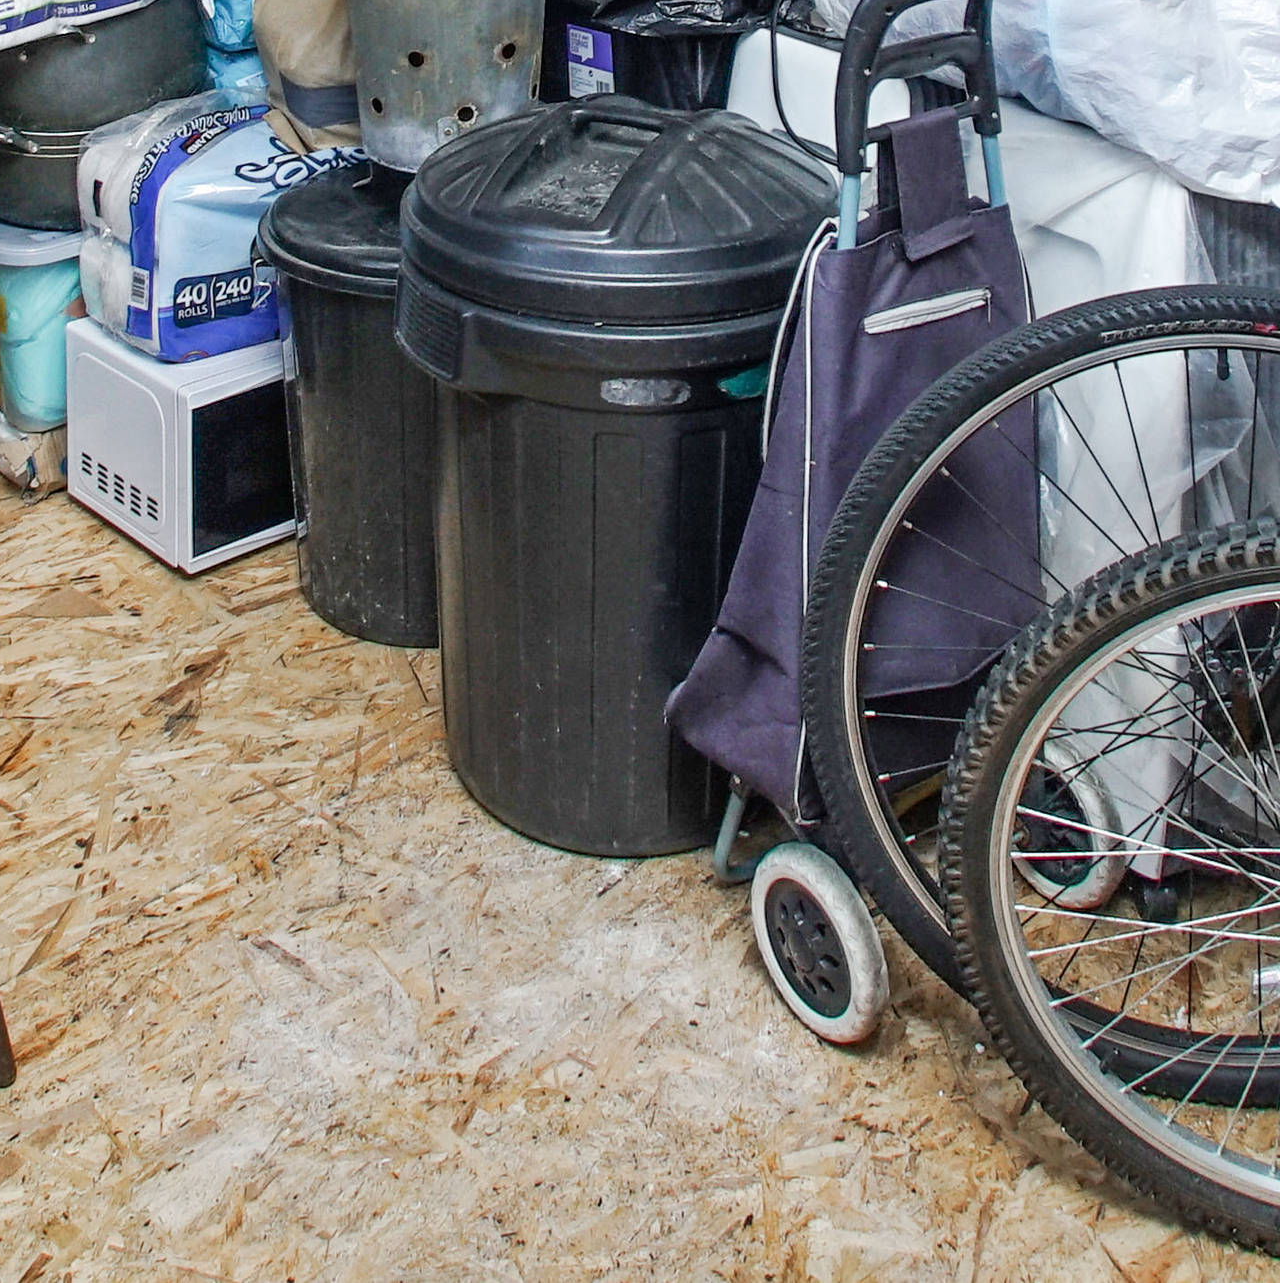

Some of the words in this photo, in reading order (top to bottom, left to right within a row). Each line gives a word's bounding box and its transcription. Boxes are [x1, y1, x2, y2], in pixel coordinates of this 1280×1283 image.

[176, 282, 208, 308] 40
[215, 276, 252, 301] 240
[178, 304, 209, 320] ROLLS
